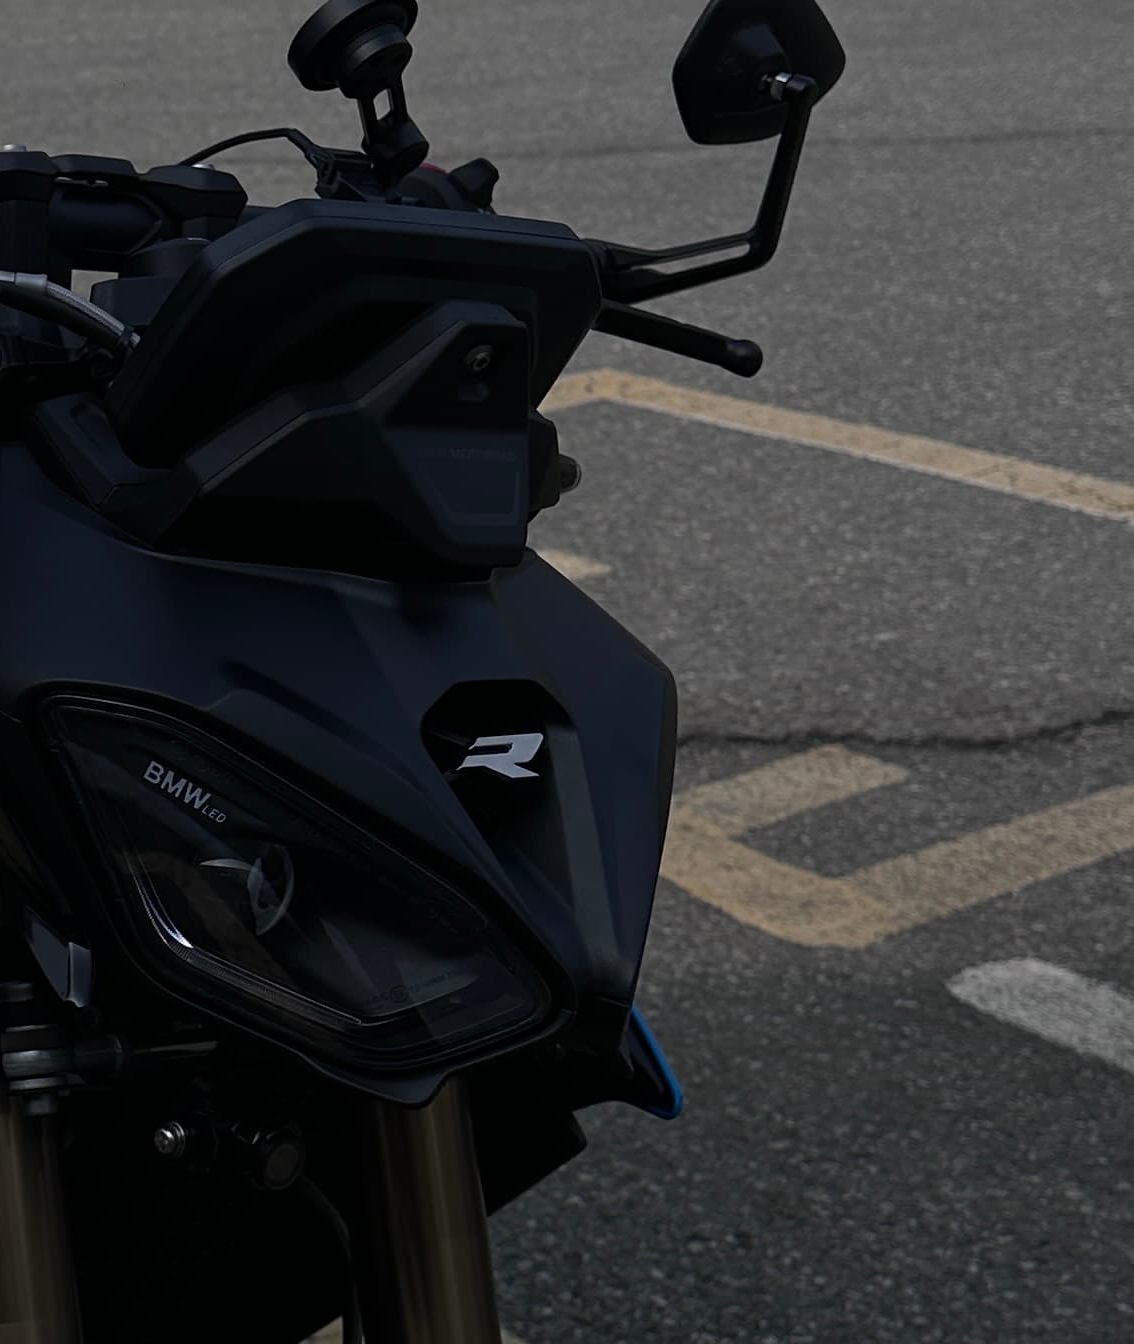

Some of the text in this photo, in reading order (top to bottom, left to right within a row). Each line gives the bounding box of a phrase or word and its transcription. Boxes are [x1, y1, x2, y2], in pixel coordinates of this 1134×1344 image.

[454, 732, 545, 778] R
[143, 760, 227, 823] BMW LED
